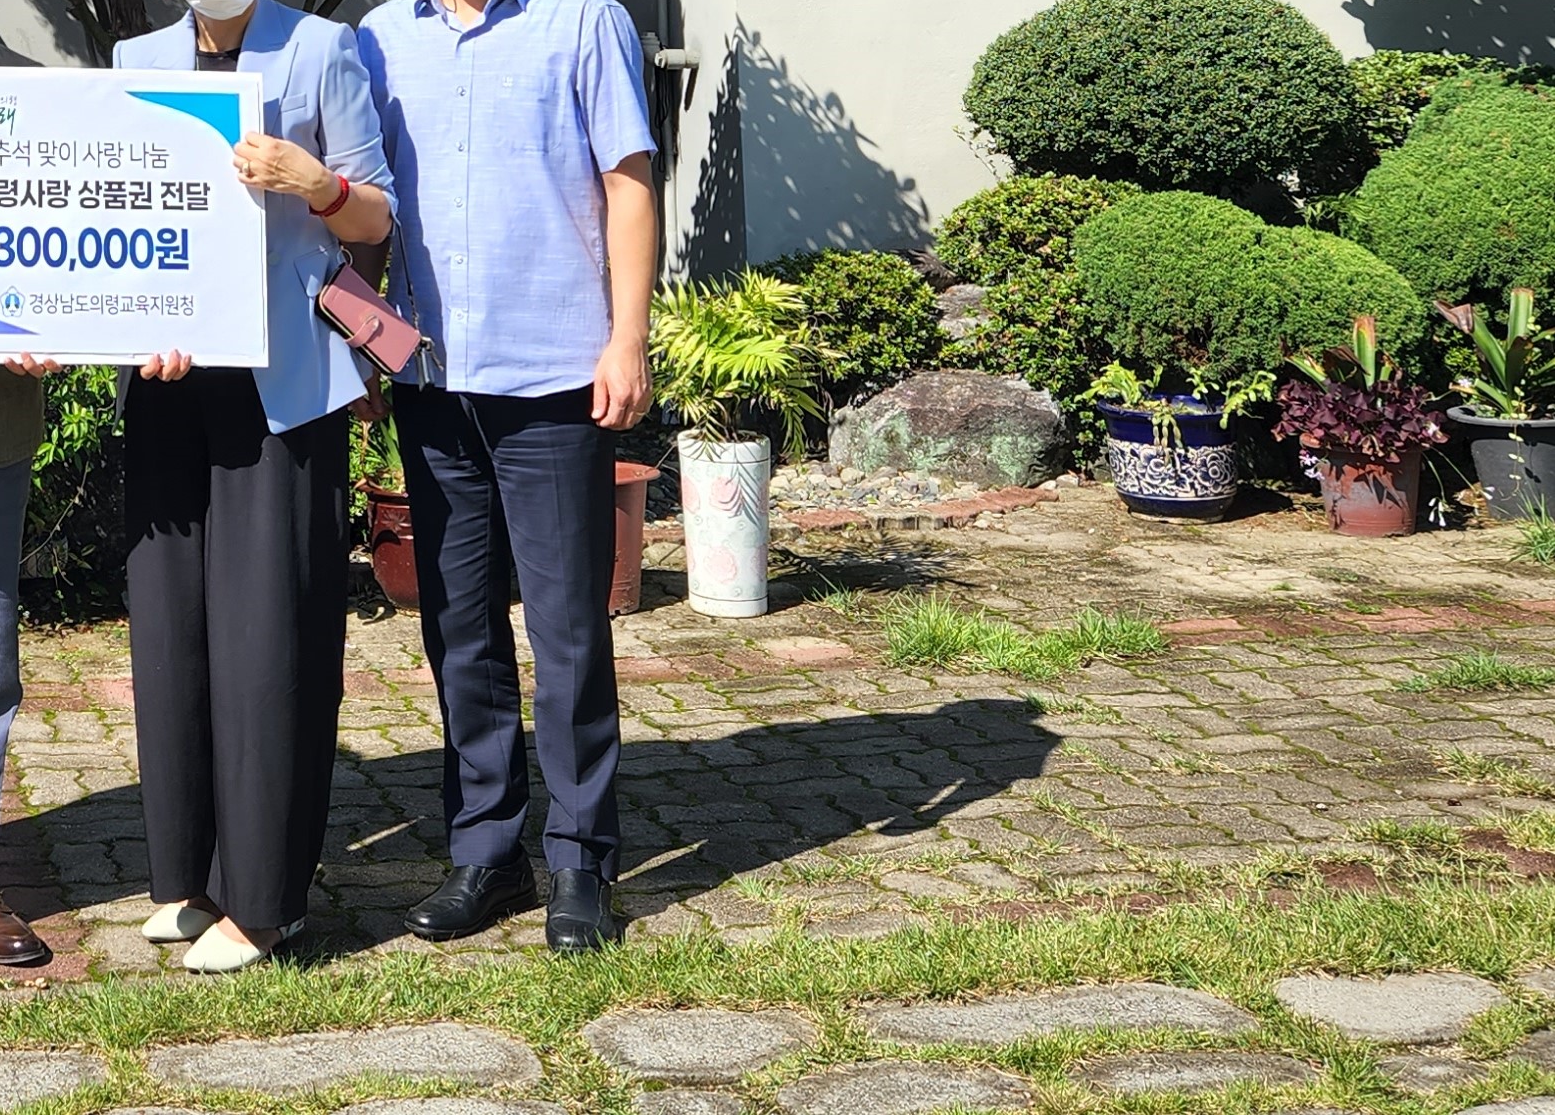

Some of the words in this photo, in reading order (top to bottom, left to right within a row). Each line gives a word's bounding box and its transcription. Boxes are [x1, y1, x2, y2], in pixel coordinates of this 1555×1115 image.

[38, 140, 77, 168] 맞이
[83, 141, 123, 168] 사랑
[130, 142, 170, 169] 나눔
[78, 180, 153, 210] 상품권
[161, 181, 211, 211] 전달
[29, 293, 195, 317] 경상남도의령교육지원청
